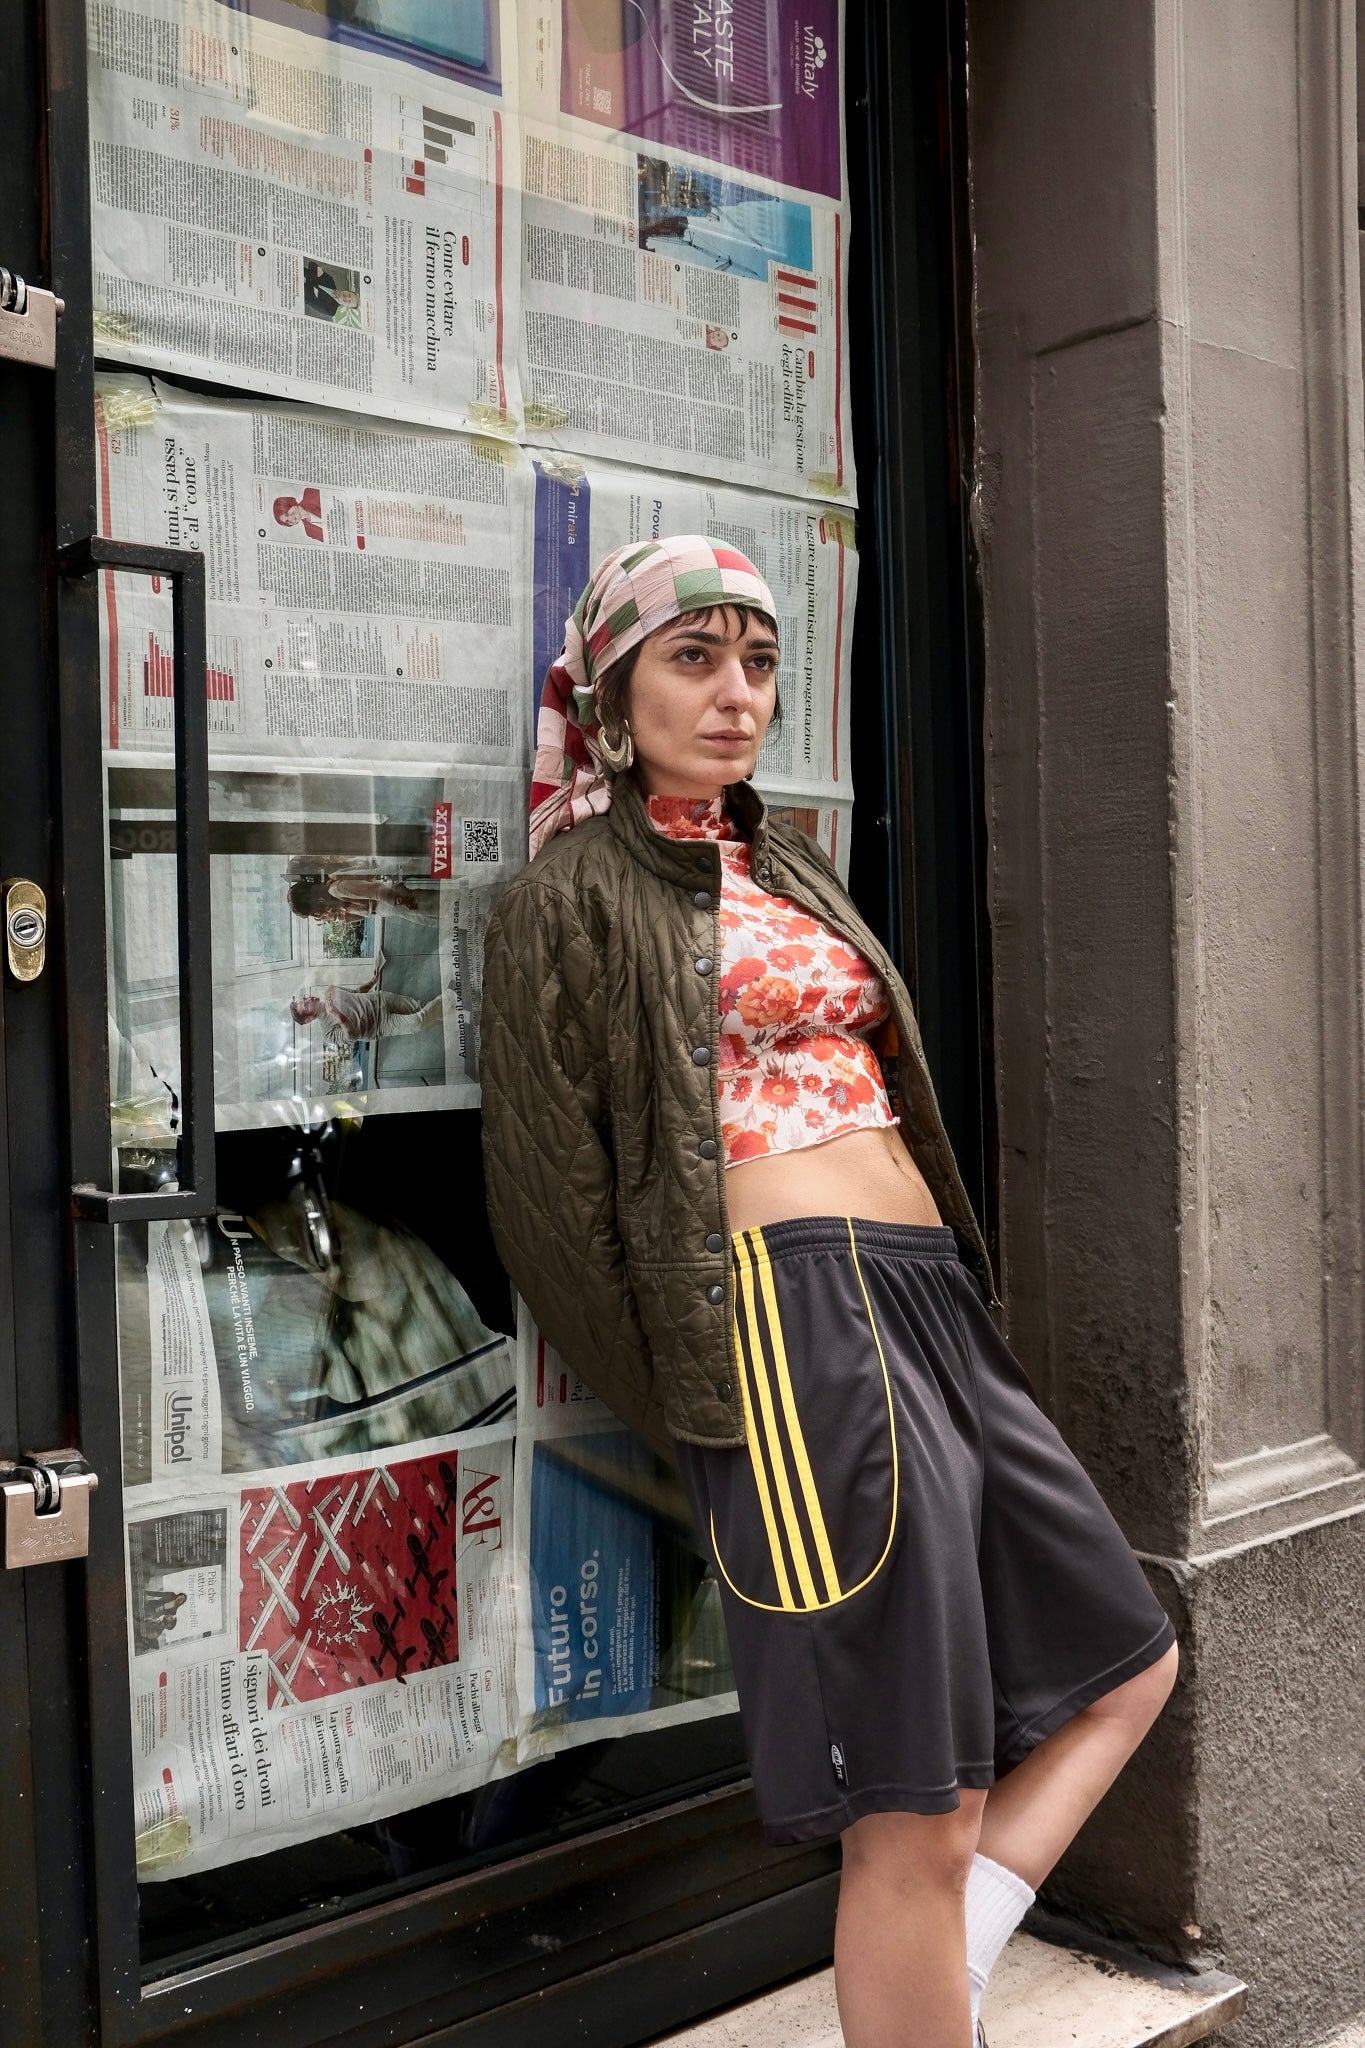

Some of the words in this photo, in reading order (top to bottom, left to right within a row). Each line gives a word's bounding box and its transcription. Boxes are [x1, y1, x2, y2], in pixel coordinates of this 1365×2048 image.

[693, 0, 712, 68] ALY
[801, 26, 819, 99] vinitaly
[170, 108, 179, 131] 31%
[426, 225, 440, 238] il
[426, 240, 440, 289] fermo
[444, 232, 456, 278] Come
[444, 282, 457, 336] evitare
[487, 303, 495, 324] 67%
[10, 330, 42, 348] CISA
[426, 292, 440, 371] macchina
[780, 344, 792, 378] degli
[795, 348, 806, 399] Cambia
[489, 377, 498, 403] MLD
[783, 380, 794, 422] edifici
[796, 402, 806, 413] la
[111, 429, 121, 454] 62%
[794, 415, 806, 473] gestione
[828, 434, 836, 454] 40%
[164, 437, 180, 484] passa
[163, 488, 178, 502] si
[183, 516, 199, 532] al
[568, 501, 577, 545] miraia
[652, 500, 662, 540] Prova
[805, 515, 816, 562] Legare
[806, 564, 817, 654] impiantistica
[806, 657, 813, 665] e
[803, 667, 814, 763] progettazione
[434, 809, 448, 873] VELUX
[452, 944, 460, 968] della
[454, 971, 462, 1002] valore
[456, 1014, 466, 1058] Aumenta
[180, 1239, 192, 1261] Unipol
[233, 1248, 245, 1278] PASSO
[189, 1282, 199, 1306] fianco,
[239, 1281, 250, 1315] AVANTI
[192, 1306, 201, 1318] per
[232, 1306, 241, 1319] LA
[197, 1319, 208, 1372] accompagnarti
[234, 1321, 244, 1342] VITA
[244, 1317, 257, 1360] INSIEME,
[239, 1353, 247, 1367] UN
[202, 1379, 210, 1419] proteggerti
[241, 1370, 255, 1413] VIAGGIO.
[164, 1396, 192, 1463] Unipol
[202, 1420, 210, 1435] ogni
[202, 1437, 210, 1460] giorno.
[462, 1465, 502, 1552] A&F
[43, 1531, 76, 1547] CISA
[208, 1571, 216, 1587] Più
[208, 1589, 216, 1604] che
[466, 1582, 475, 1640] Affari&Finanza
[580, 1550, 599, 1659] corso.
[246, 1654, 262, 1662] I
[548, 1585, 571, 1707] Futuro
[220, 1660, 235, 1710] fanno
[243, 1665, 262, 1724] signori
[469, 1673, 479, 1699] Pochi
[485, 1670, 493, 1692] Casa
[576, 1669, 601, 1700] in
[330, 1710, 338, 1723] La
[456, 1692, 467, 1718] piano
[472, 1701, 484, 1733] alloggi
[223, 1714, 244, 1759] affari
[313, 1715, 322, 1728] gli
[345, 1707, 355, 1737] Dubai
[460, 1720, 469, 1738] non
[252, 1727, 268, 1754] dei
[329, 1726, 340, 1754] paura
[317, 1729, 334, 1794] investimenti
[335, 1756, 348, 1793] sgonfia
[256, 1759, 275, 1808] droni
